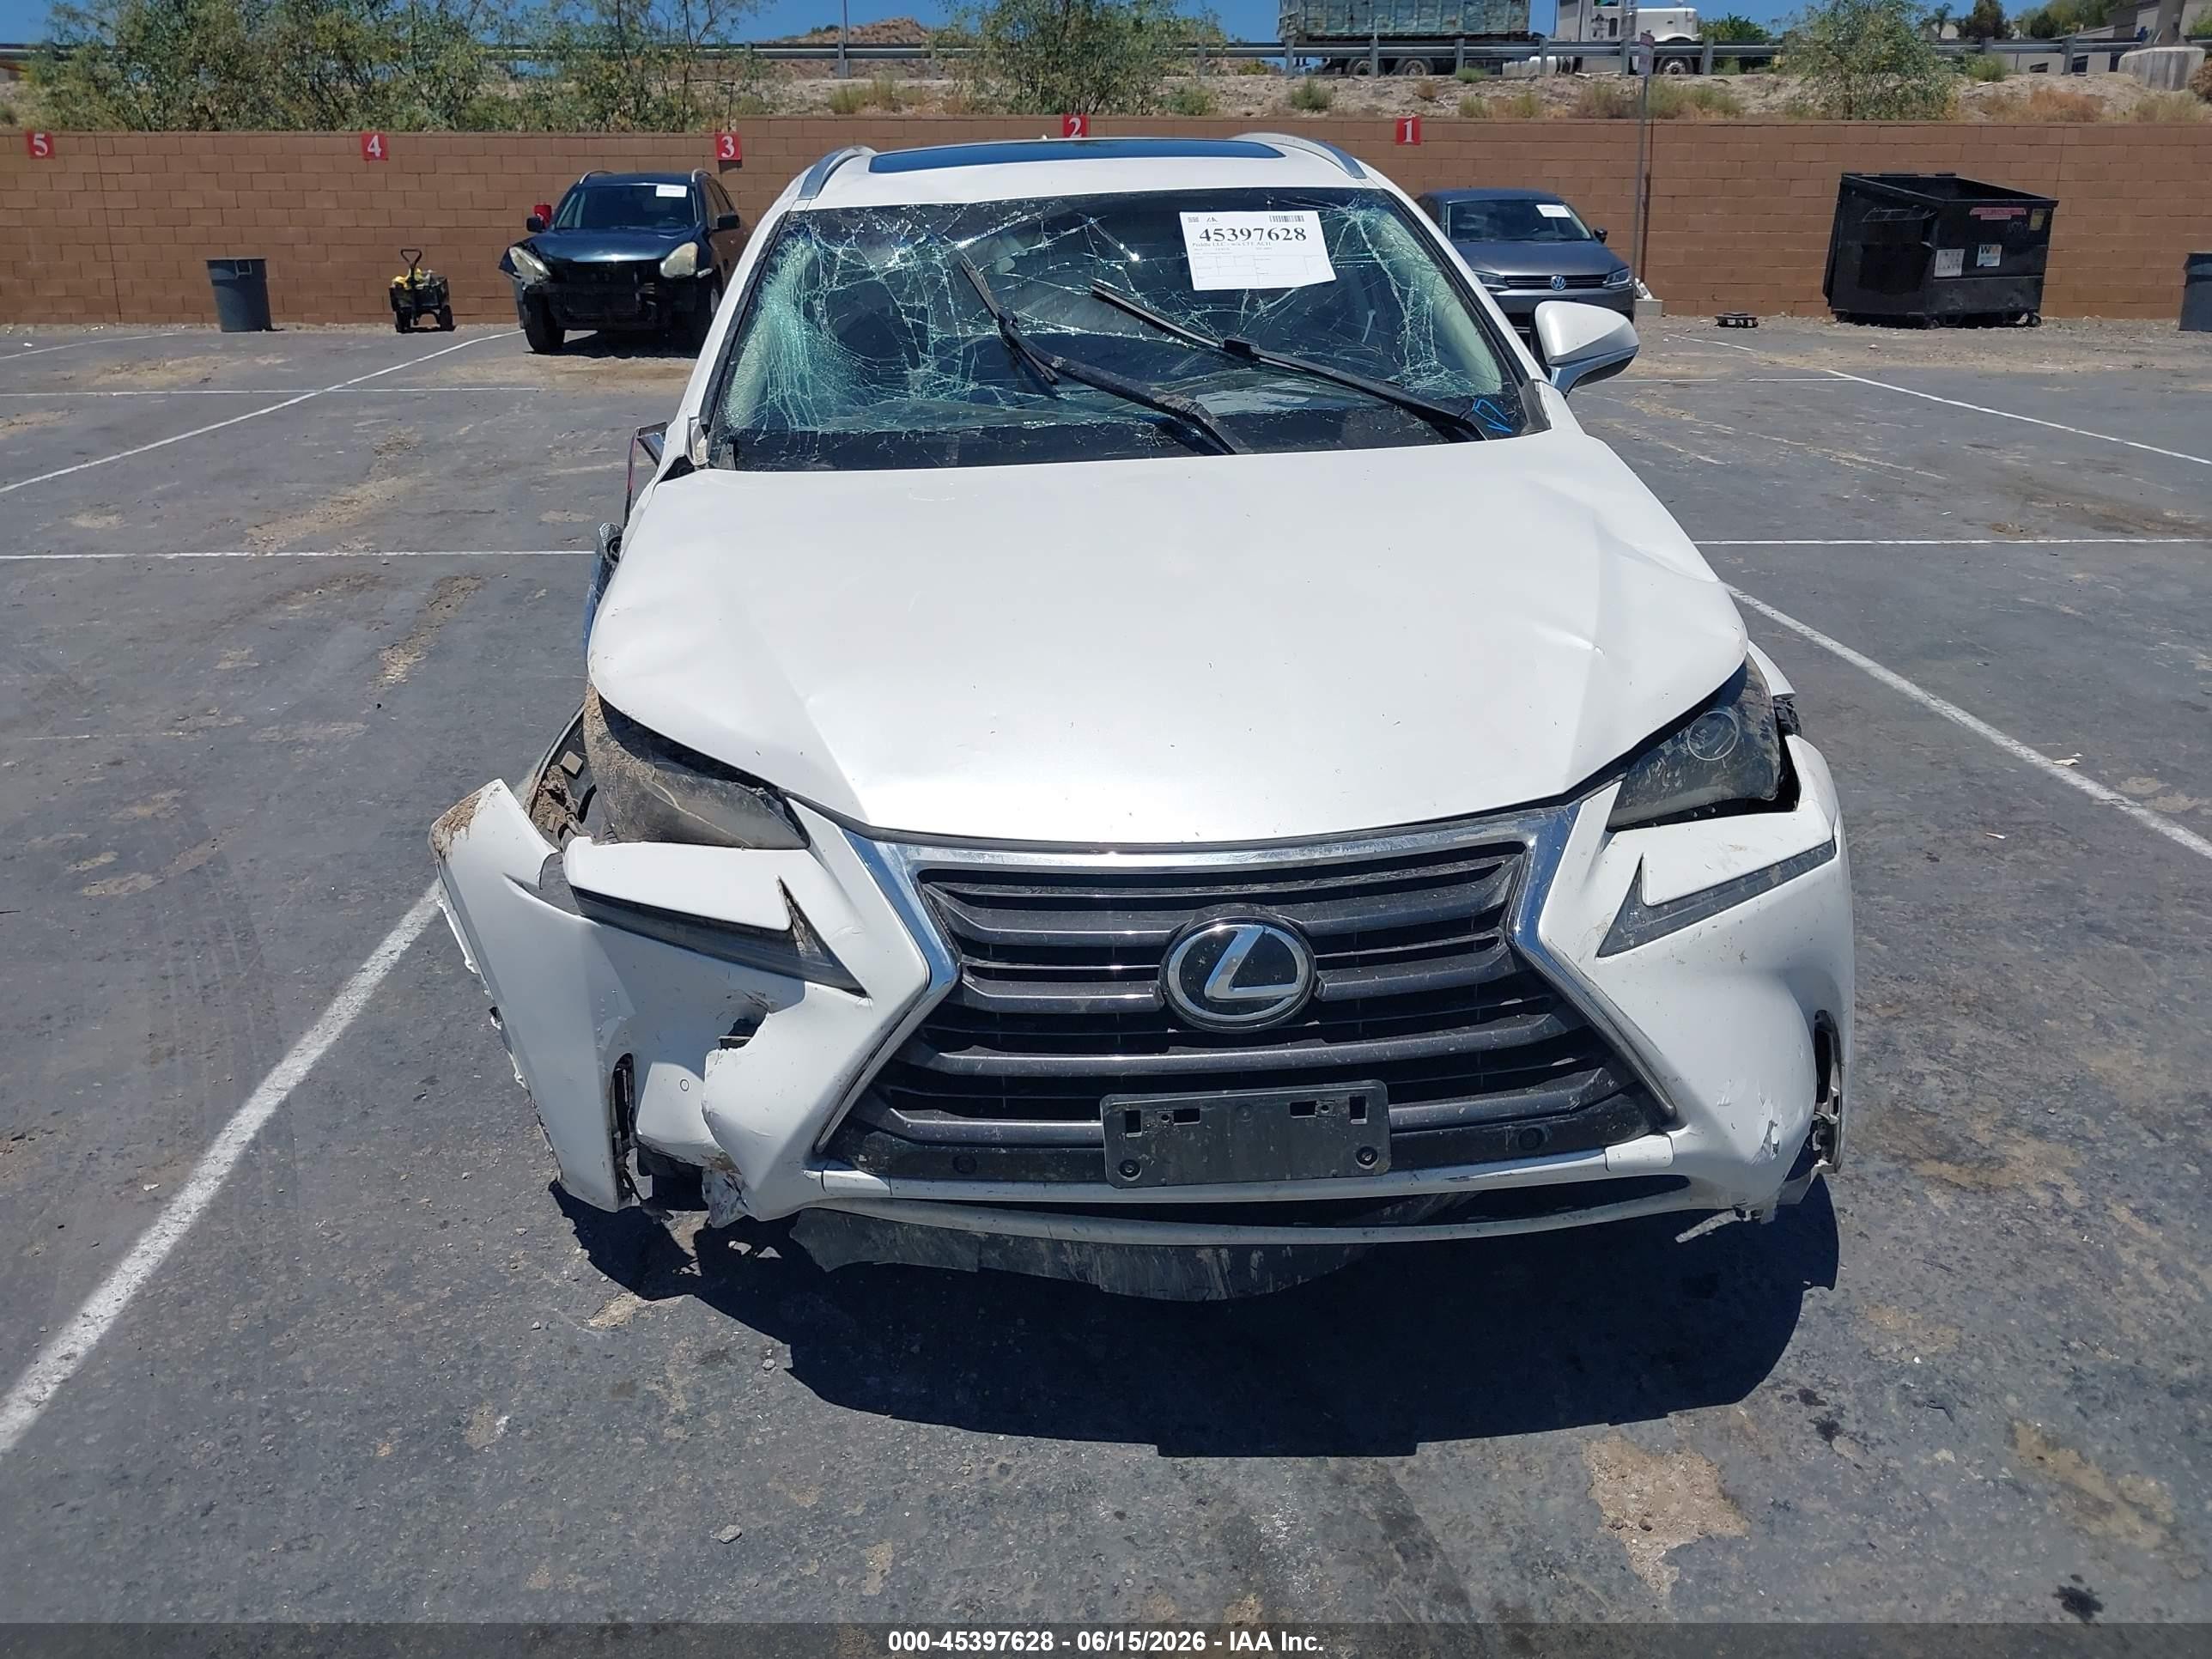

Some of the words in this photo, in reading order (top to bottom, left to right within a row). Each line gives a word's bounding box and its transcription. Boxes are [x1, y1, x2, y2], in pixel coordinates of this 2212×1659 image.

[1068, 117, 1083, 137] 2
[1403, 120, 1415, 143] 1
[33, 133, 49, 156] 5
[367, 134, 382, 157] 4
[720, 136, 736, 158] 3
[1199, 227, 1307, 242] 45397628
